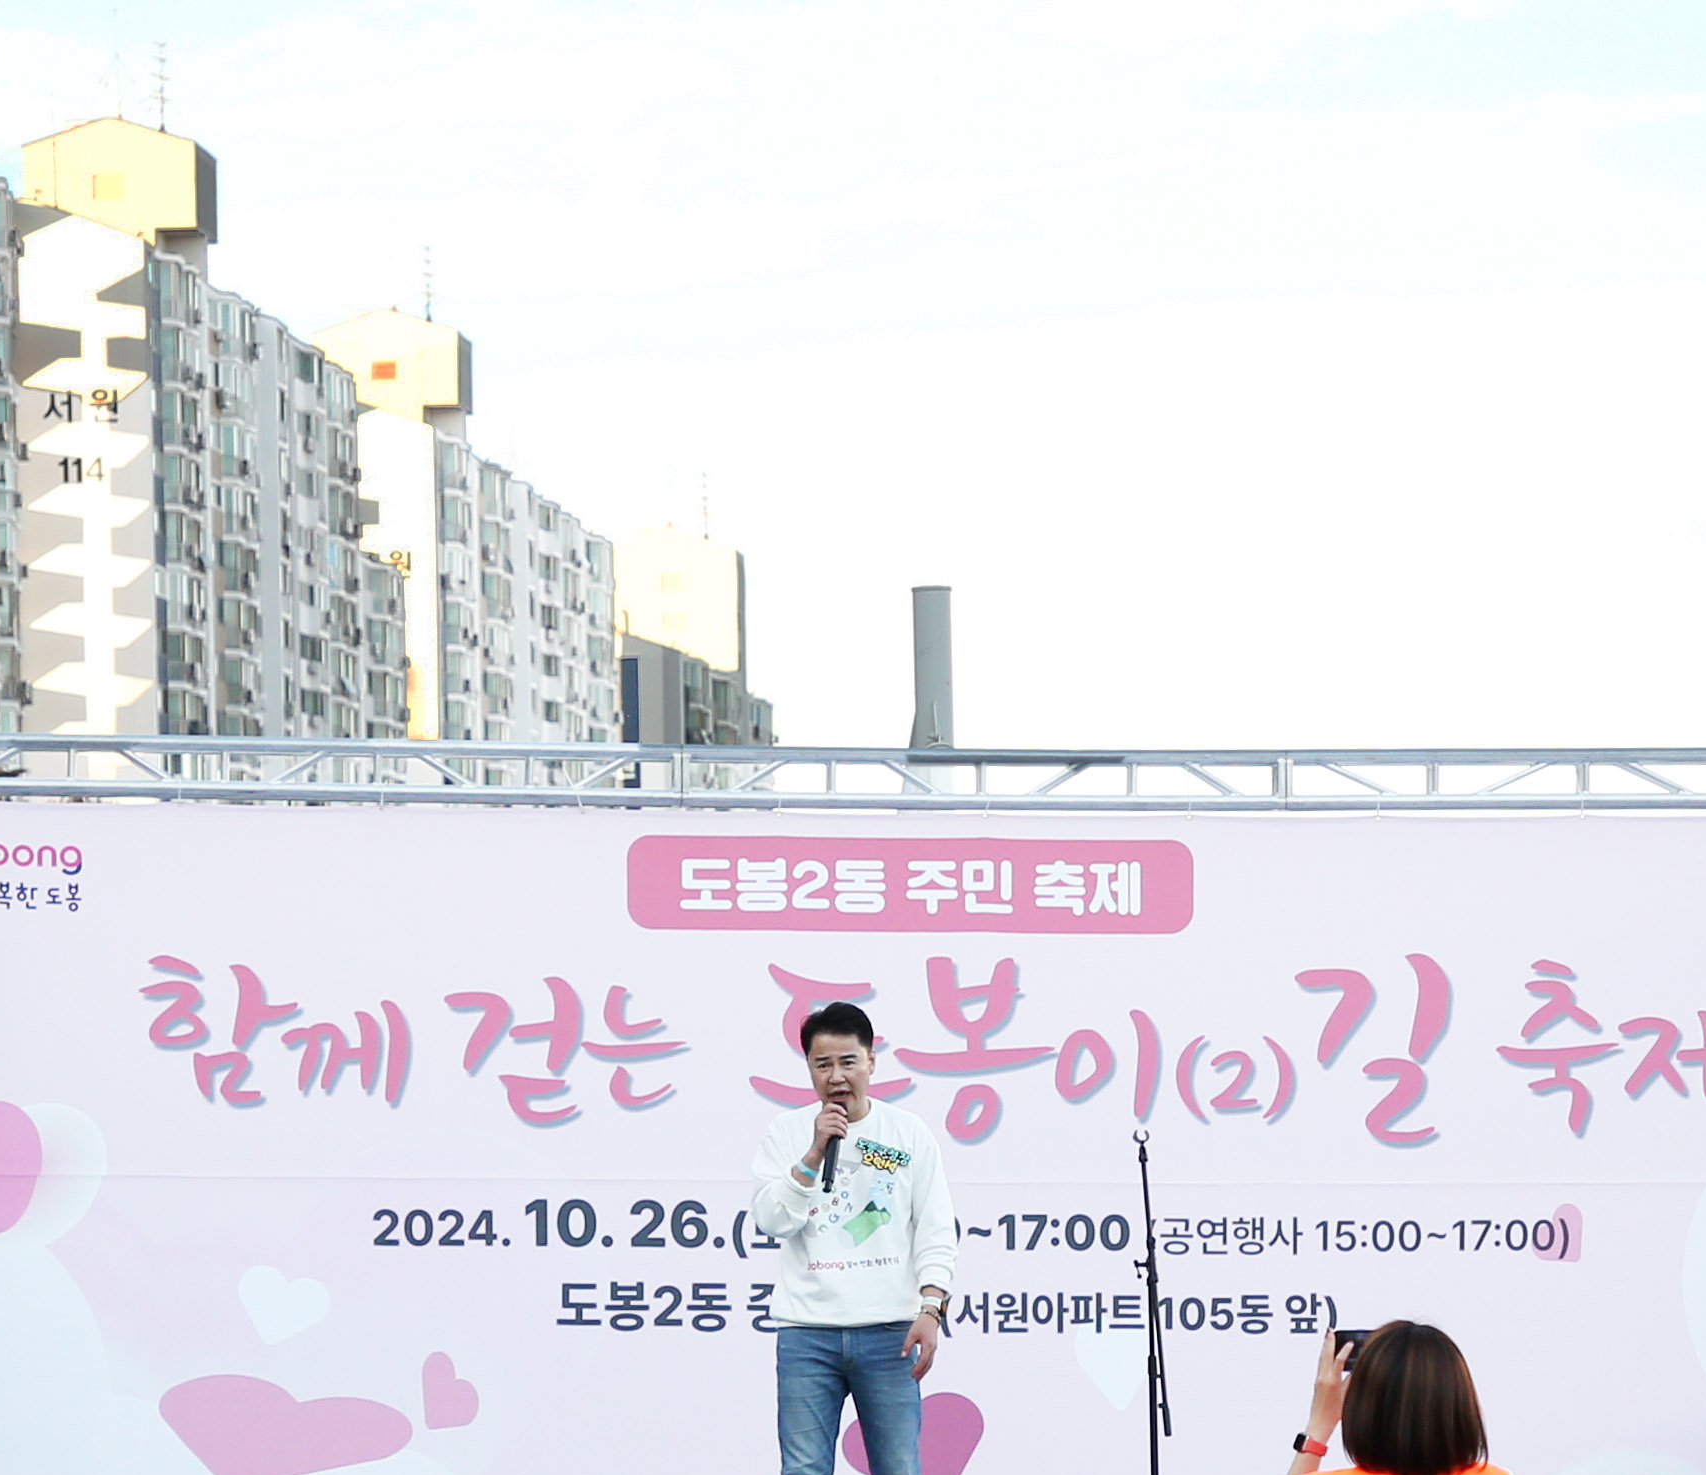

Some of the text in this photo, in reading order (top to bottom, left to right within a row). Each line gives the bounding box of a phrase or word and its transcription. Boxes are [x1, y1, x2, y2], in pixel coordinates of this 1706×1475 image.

[58, 456, 105, 484] 114
[45, 882, 82, 912] 도봉
[679, 857, 1143, 917] 도봉2동 주민 축제
[138, 954, 414, 1109] 함께
[443, 975, 691, 1129] 걷는
[372, 1208, 511, 1247] 2024.
[525, 1198, 614, 1248] 10.
[1316, 1217, 1571, 1259] 15:00~17:00)
[556, 1281, 733, 1333] 도봉2동
[1157, 1294, 1275, 1334] 105동
[1284, 1294, 1338, 1336] 앞)
